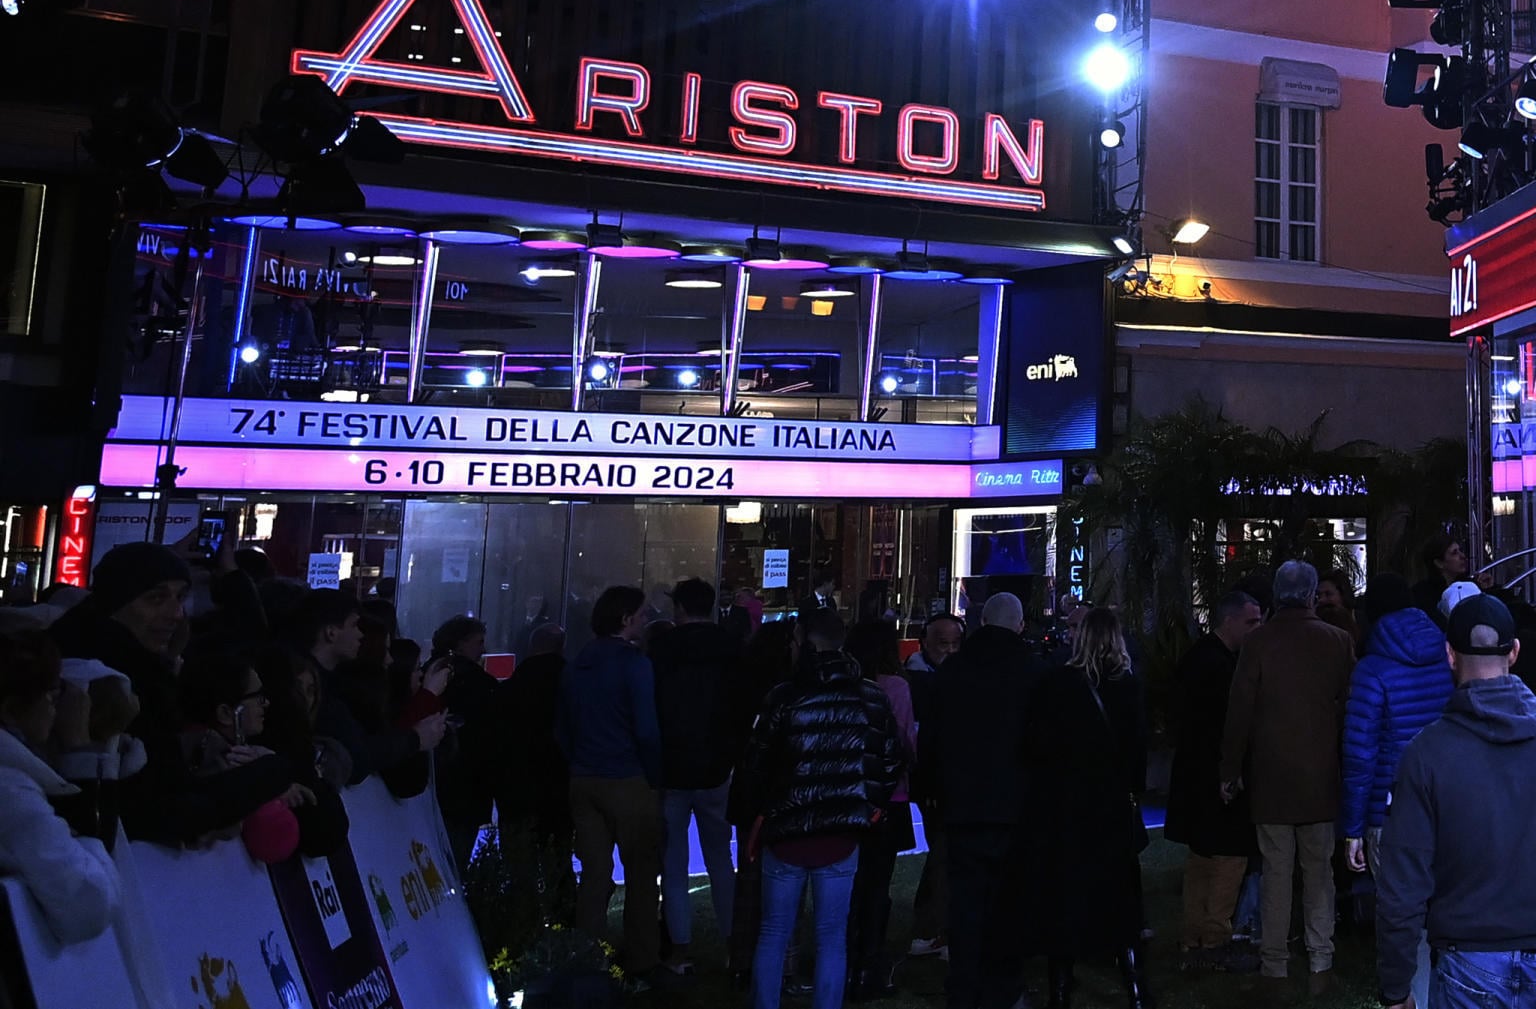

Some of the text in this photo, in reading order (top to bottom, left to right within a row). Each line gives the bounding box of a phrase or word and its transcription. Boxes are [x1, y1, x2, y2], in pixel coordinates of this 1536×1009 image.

[1026, 358, 1053, 380] eni
[298, 410, 467, 441] FESTIVAL
[485, 417, 592, 444] DELLA
[611, 421, 757, 448] CANZONE
[773, 425, 896, 452] ITALIANA
[467, 462, 636, 489] FEBBRAIO
[652, 465, 735, 490] 2024
[975, 472, 1023, 487] Cinema
[312, 871, 341, 920] Rai
